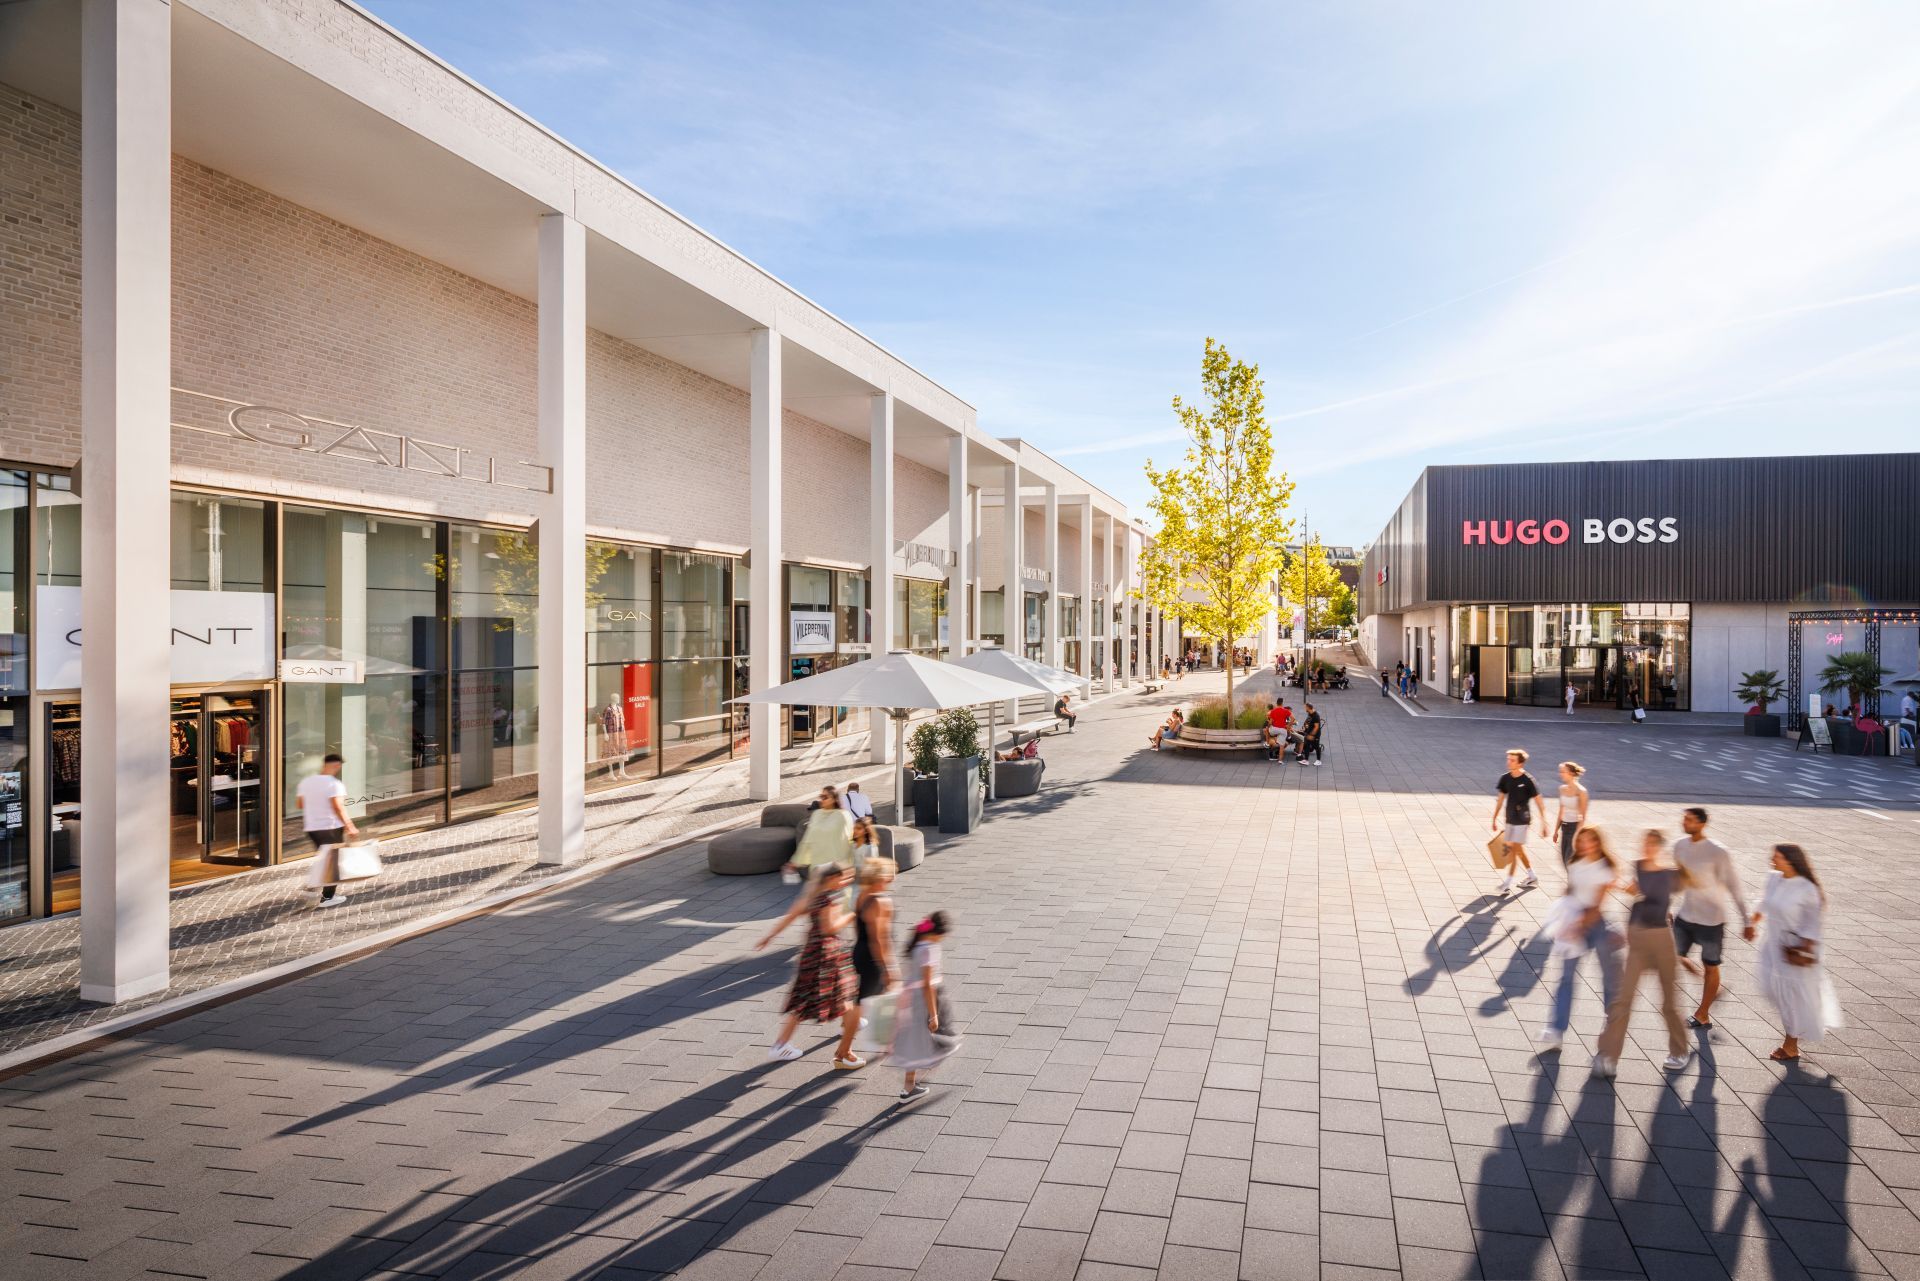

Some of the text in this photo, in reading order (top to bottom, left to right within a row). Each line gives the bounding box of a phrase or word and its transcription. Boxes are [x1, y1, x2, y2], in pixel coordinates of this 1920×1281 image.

[1463, 517, 1679, 545] HUGO BOSS
[607, 610, 667, 621] GAN
[65, 627, 253, 646] NT
[796, 623, 830, 642] VILEBREQUIN
[291, 667, 347, 676] GANT
[343, 789, 398, 807] GANT
